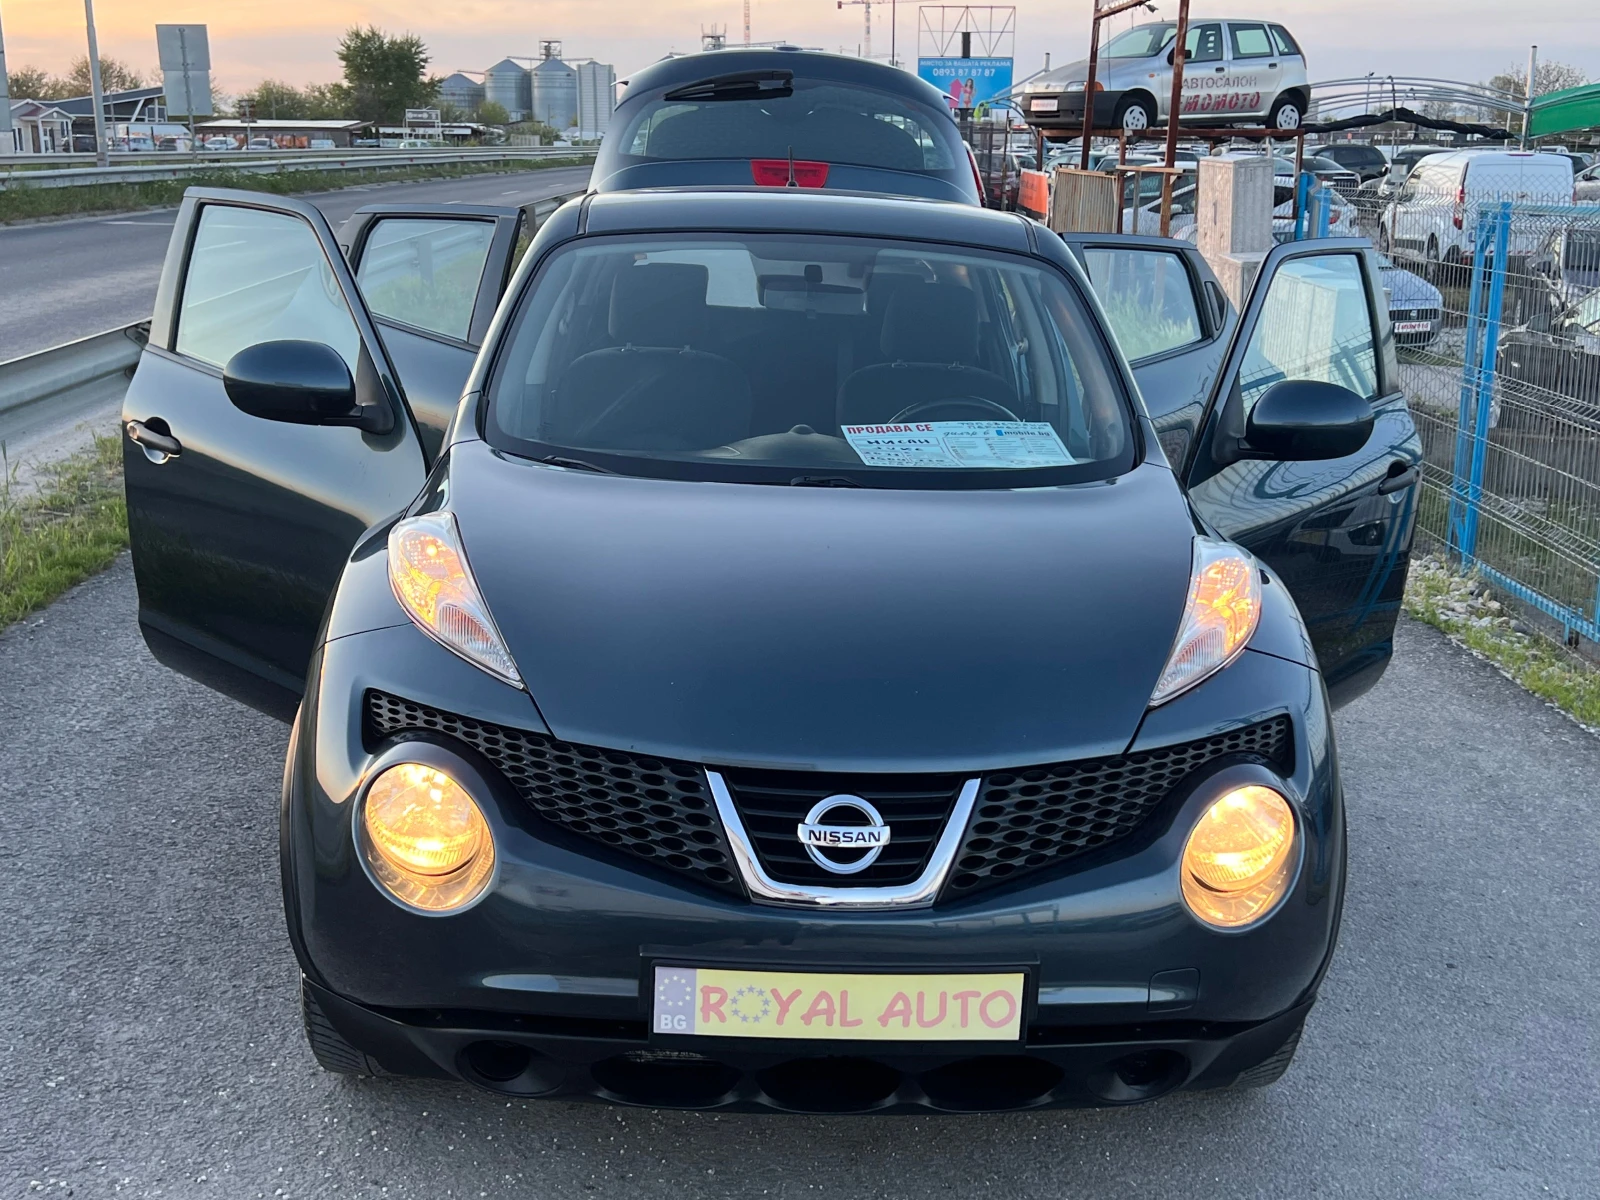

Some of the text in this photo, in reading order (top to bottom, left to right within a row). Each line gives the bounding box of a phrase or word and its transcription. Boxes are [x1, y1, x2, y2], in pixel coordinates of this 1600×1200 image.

[932, 68, 996, 77] 0893 87 87 87
[1183, 76, 1257, 90] АВТОСАЛОН
[1180, 92, 1260, 112] МОМОТО
[846, 423, 934, 434] ПРОДАВА СЕ
[808, 829, 881, 843] NISSAN
[700, 985, 1017, 1029] ROYAL AUTO
[660, 1014, 687, 1030] BG
